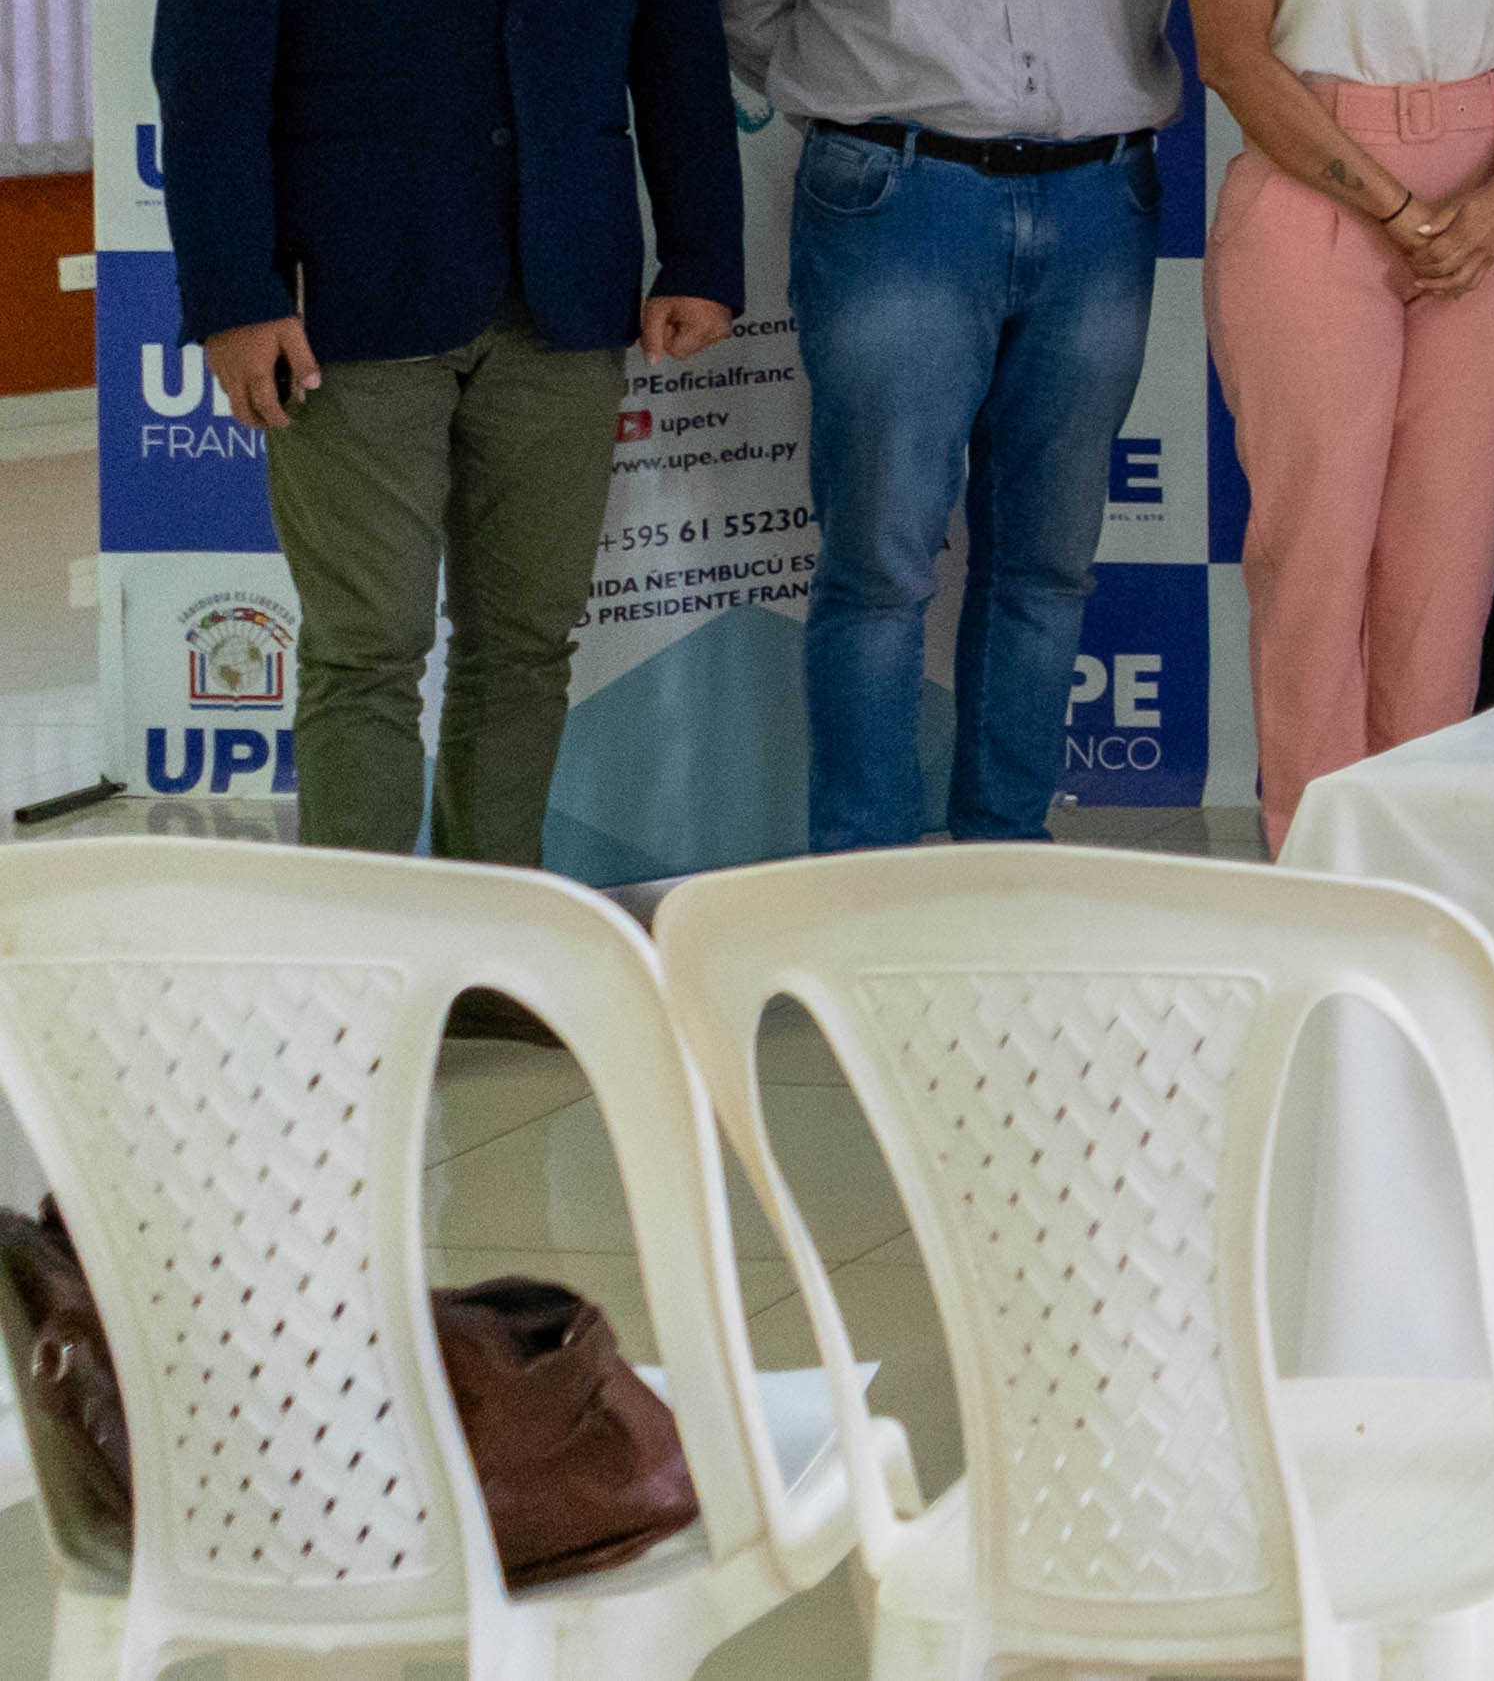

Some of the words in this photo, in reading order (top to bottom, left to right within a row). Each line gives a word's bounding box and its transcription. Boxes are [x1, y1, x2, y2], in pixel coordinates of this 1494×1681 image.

[660, 412, 729, 436] upetv
[142, 426, 266, 458] FRAN
[600, 522, 669, 554] +595
[680, 518, 710, 543] 61
[600, 589, 742, 625] PRESIDENTE
[749, 581, 810, 605] FRAN
[1065, 654, 1161, 727] PE
[1065, 736, 1161, 770] NCO
